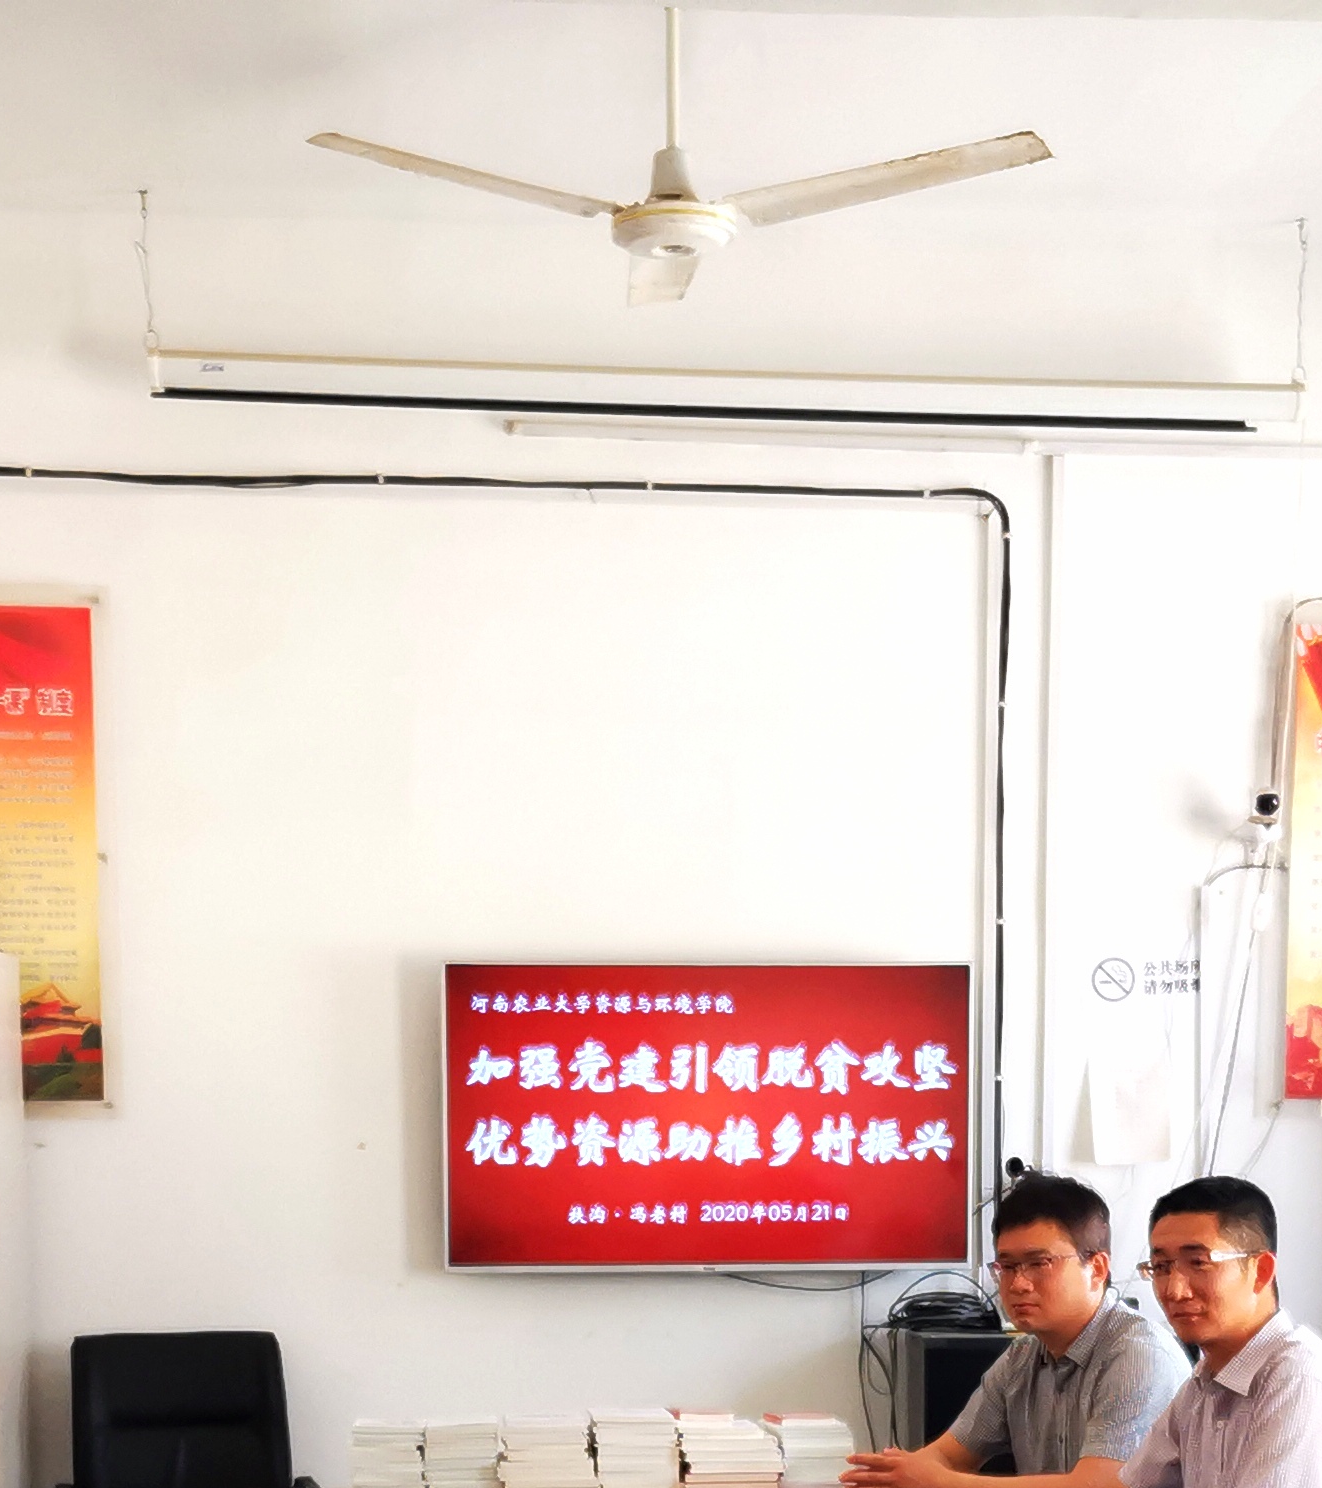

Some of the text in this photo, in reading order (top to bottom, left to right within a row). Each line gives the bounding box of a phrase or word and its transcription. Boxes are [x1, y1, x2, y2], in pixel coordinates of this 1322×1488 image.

[470, 991, 735, 1015] 河南农业大学资源与环境学院
[465, 1036, 958, 1096] 加强党建引领脱贫攻坚
[465, 1110, 956, 1168] 优势资源助推乡村振兴
[699, 1201, 850, 1225] 2020年05月21日
